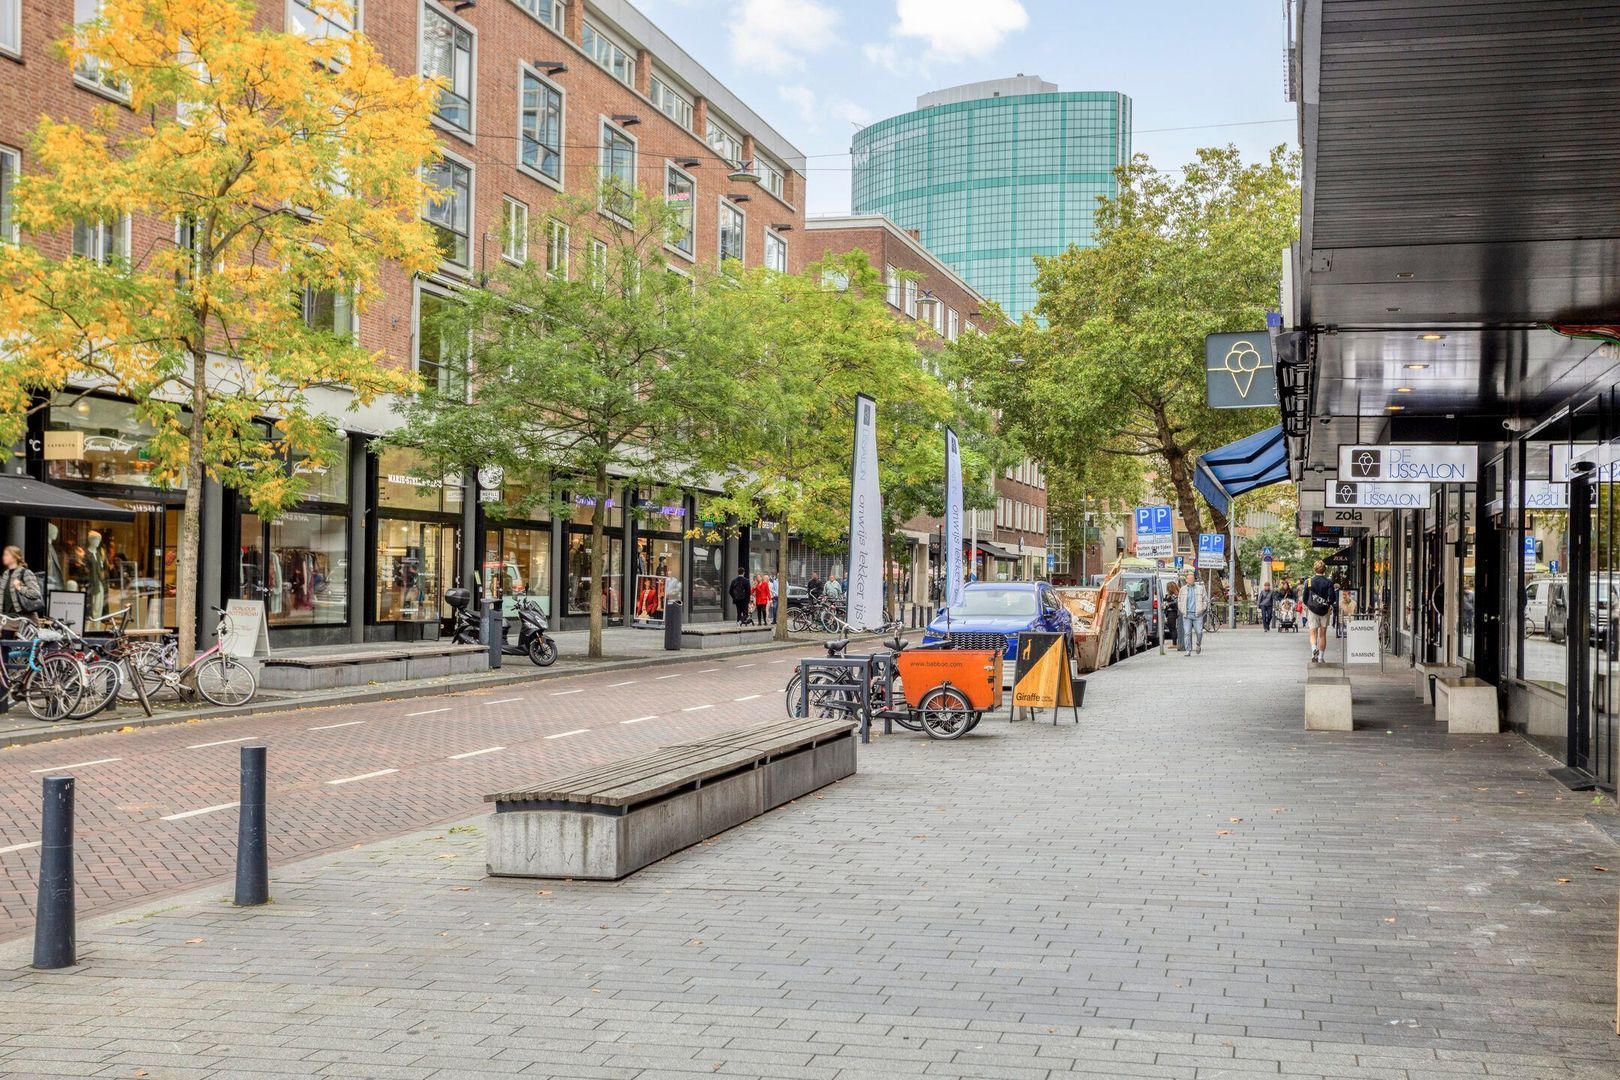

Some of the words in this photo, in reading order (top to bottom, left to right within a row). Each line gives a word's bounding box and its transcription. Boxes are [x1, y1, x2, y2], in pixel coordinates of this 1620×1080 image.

[1389, 449, 1411, 463] DE
[1389, 464, 1465, 478] IJSSALON
[1364, 494, 1421, 505] IJSSALON
[859, 494, 868, 547] onwijs
[1140, 510, 1149, 524] P
[1157, 509, 1167, 523] P
[1335, 509, 1362, 521] zola
[856, 550, 868, 599] lekker
[1015, 692, 1041, 703] Giraffe
